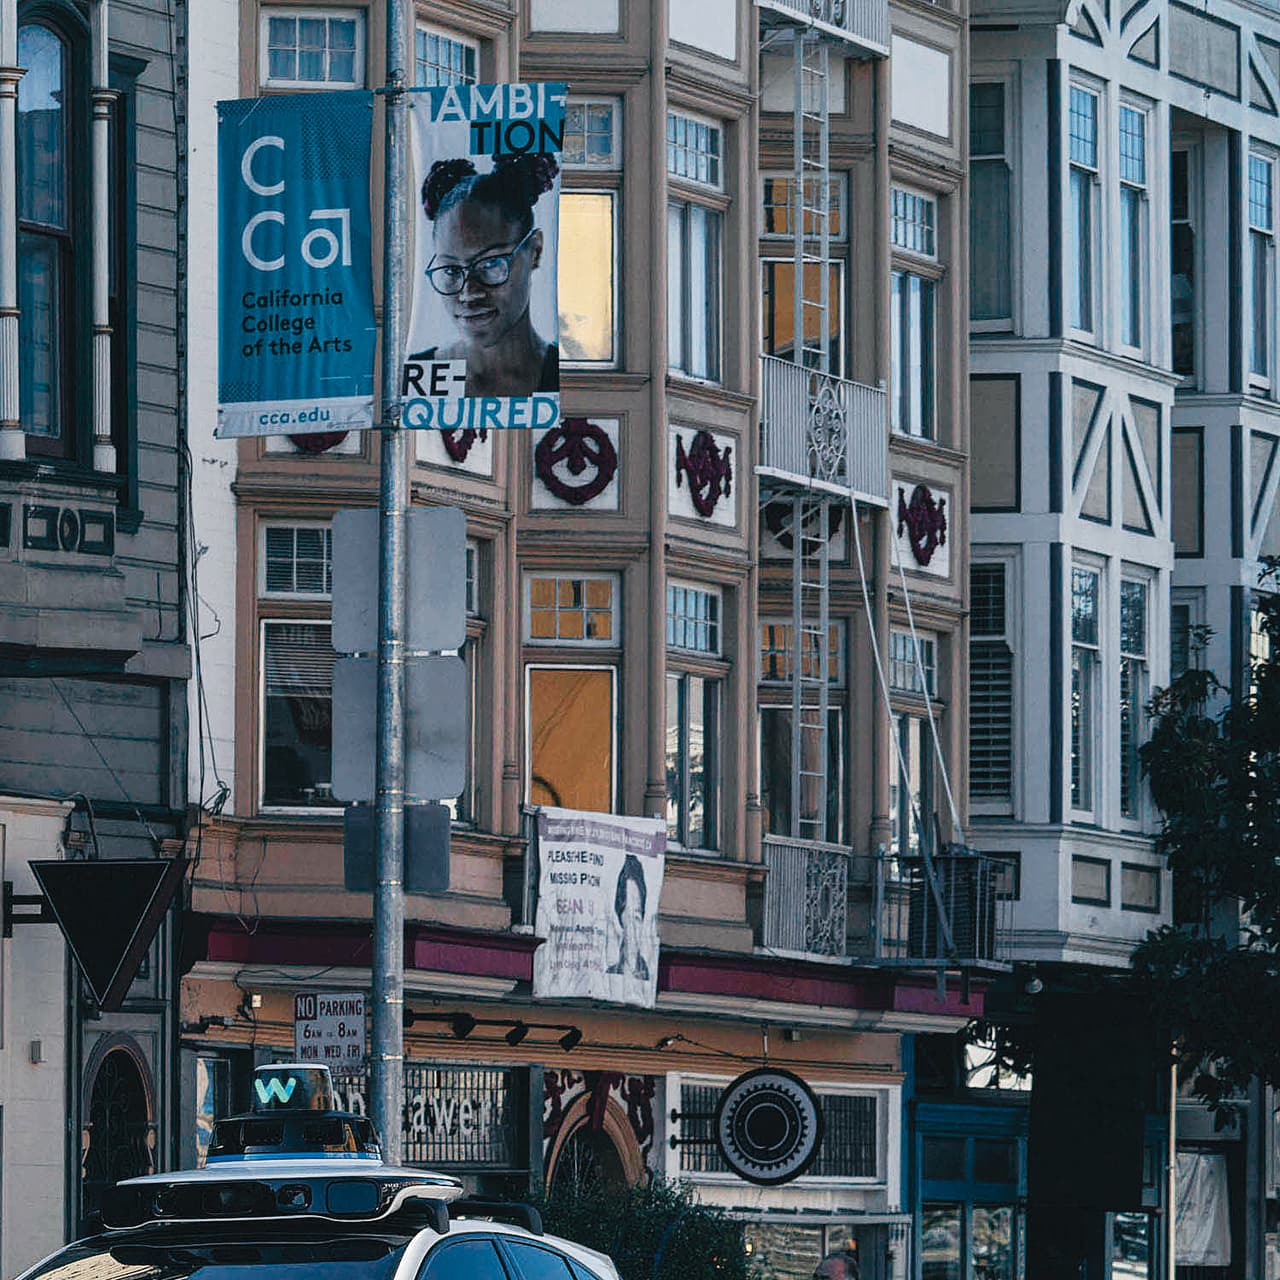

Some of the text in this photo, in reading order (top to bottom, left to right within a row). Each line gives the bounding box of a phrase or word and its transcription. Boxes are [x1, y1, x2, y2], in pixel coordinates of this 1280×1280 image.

[436, 83, 565, 123] AMBI-
[471, 120, 564, 155] TION
[242, 288, 343, 309] California
[242, 315, 316, 336] College
[242, 336, 353, 357] of the Arts
[402, 363, 466, 397] RE-
[259, 407, 331, 426] cca.edu
[402, 397, 559, 429] QUIRED
[297, 996, 363, 1018] NO PARKING
